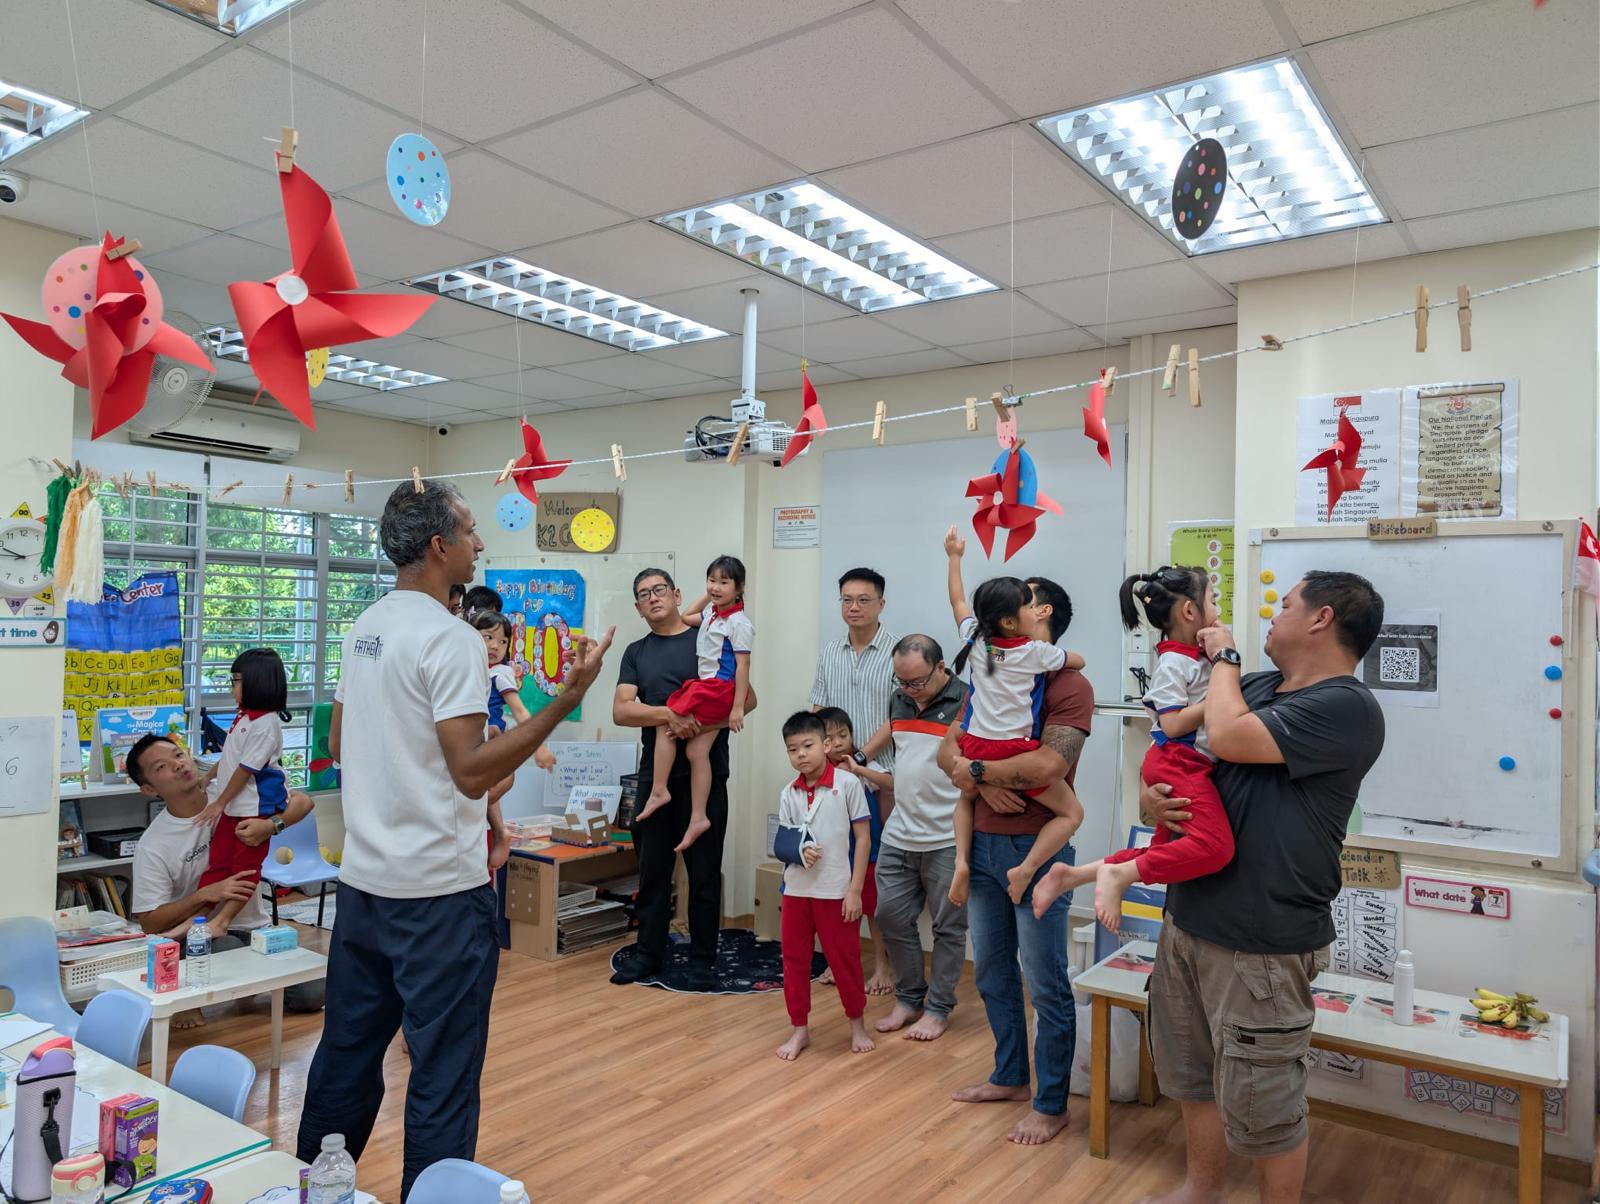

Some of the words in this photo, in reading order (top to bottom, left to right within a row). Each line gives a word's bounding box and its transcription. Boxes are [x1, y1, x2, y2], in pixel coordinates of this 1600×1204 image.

[538, 523, 558, 548] K2
[1370, 522, 1432, 536] Whiteboard
[18, 576, 24, 584] 6
[121, 582, 164, 603] Center
[496, 579, 526, 599] Happy
[528, 578, 576, 600] Birthday
[10, 628, 38, 638] time
[132, 658, 144, 668] Ee
[164, 652, 179, 666] Gg
[164, 676, 180, 686] Nn
[6, 756, 20, 776] 6
[1341, 850, 1384, 864] alendar
[1342, 867, 1370, 882] Talk
[1414, 888, 1440, 899] What
[1442, 892, 1466, 903] date
[1492, 896, 1500, 904] 7
[1366, 900, 1386, 912] Sunday
[1364, 924, 1386, 936] Tuesday
[1366, 952, 1384, 968] Friday
[1363, 964, 1388, 980] Saturday
[1328, 1062, 1352, 1072] December
[1415, 1088, 1424, 1098] 28
[1480, 1088, 1490, 1096] 24
